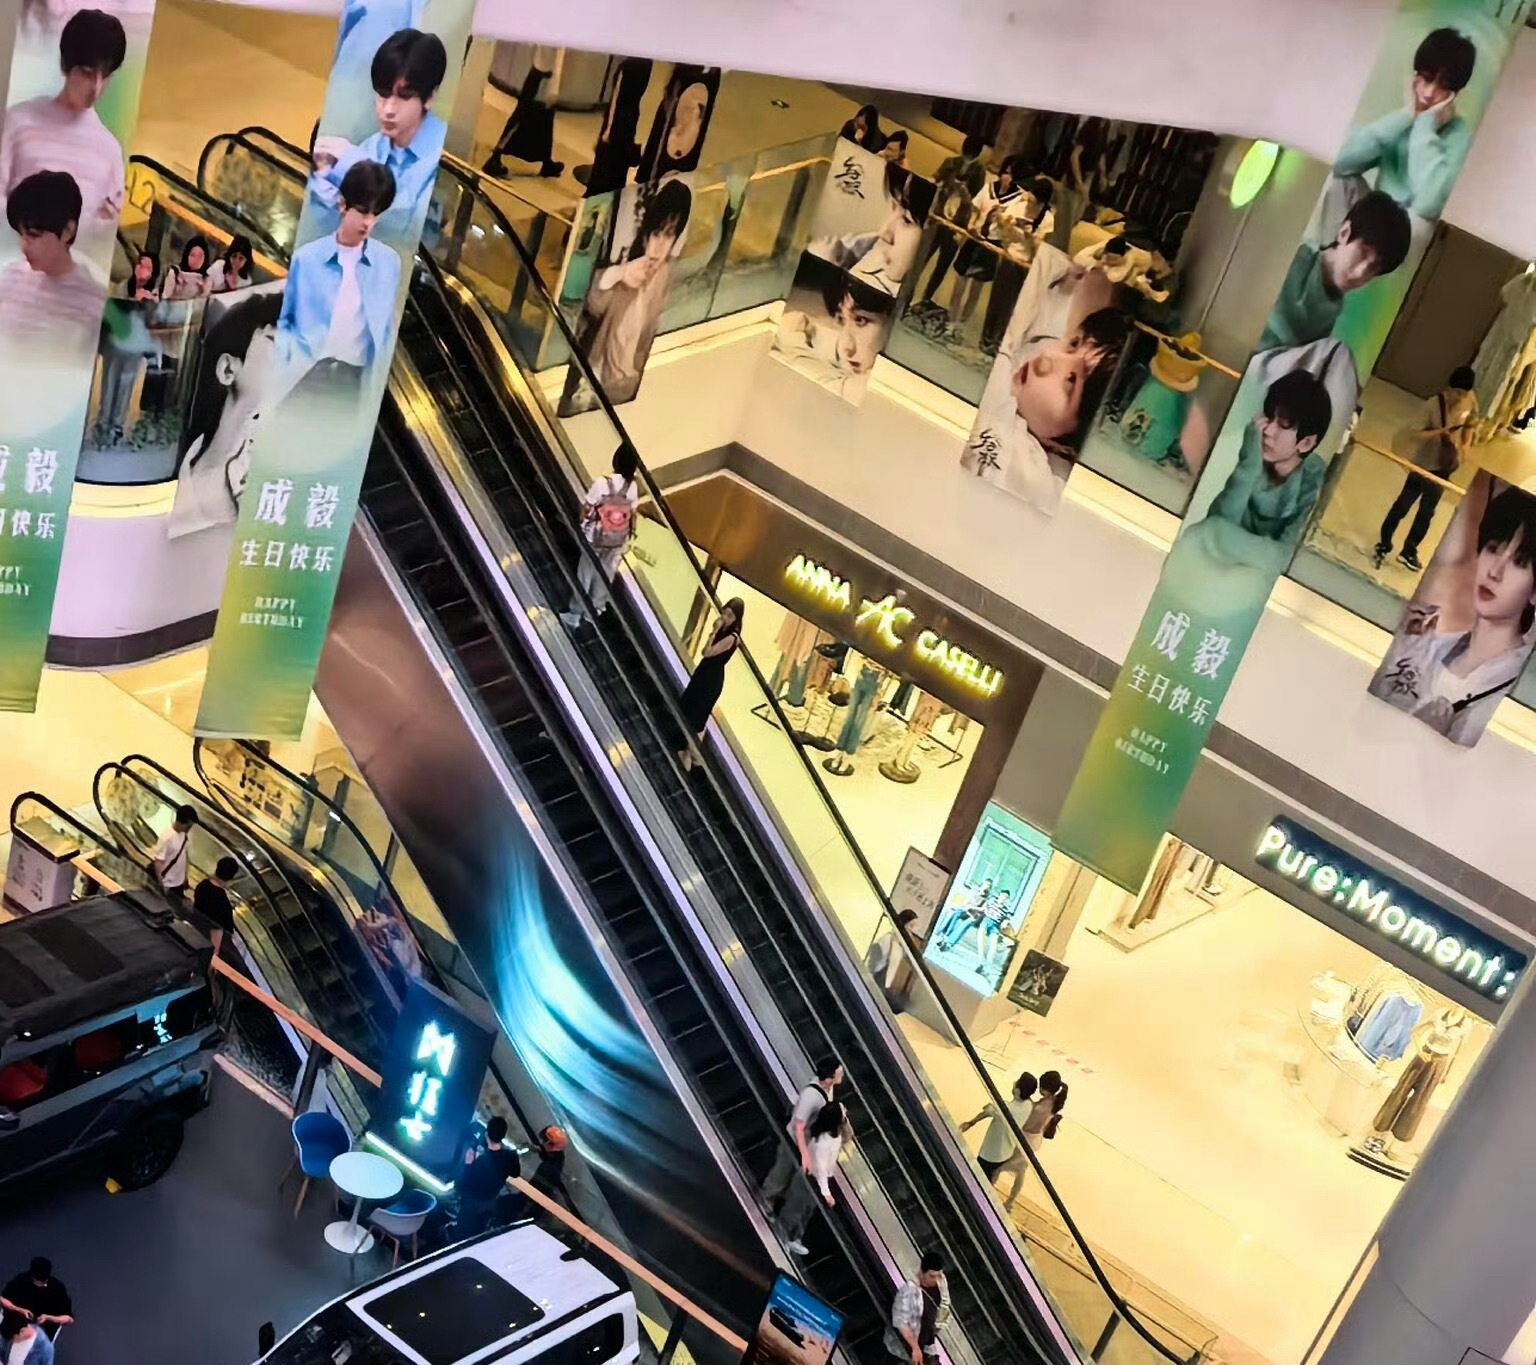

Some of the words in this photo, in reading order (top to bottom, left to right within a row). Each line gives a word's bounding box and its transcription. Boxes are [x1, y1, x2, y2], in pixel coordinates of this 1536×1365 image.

[240, 541, 333, 572] 生日快乐
[1127, 663, 1212, 728] 生日快乐
